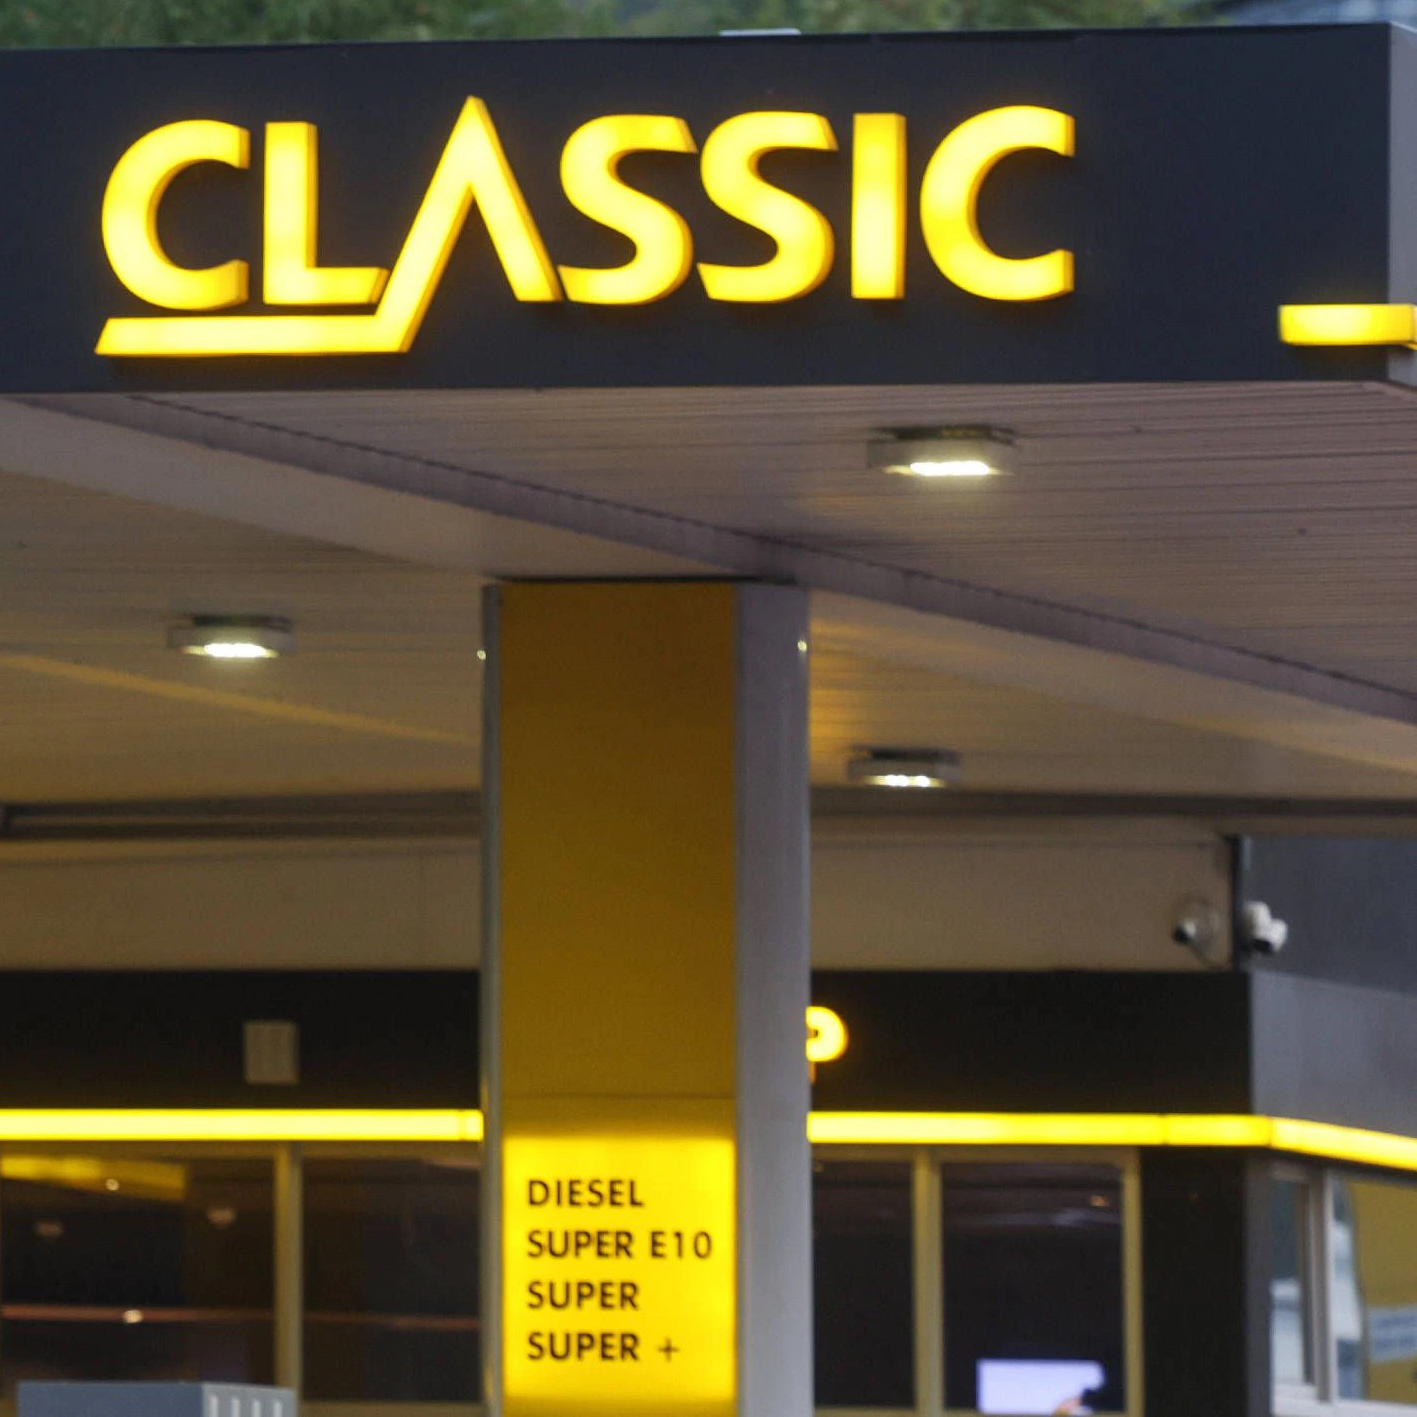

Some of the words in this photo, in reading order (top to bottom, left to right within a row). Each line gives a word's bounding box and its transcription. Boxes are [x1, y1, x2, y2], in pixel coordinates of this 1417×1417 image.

[95, 95, 1076, 356] CLASSIC
[526, 1179, 645, 1208] DIESEL
[526, 1230, 635, 1260] SUPER
[650, 1230, 713, 1260] E10
[526, 1282, 640, 1311] SUPER
[526, 1332, 641, 1362] SUPER
